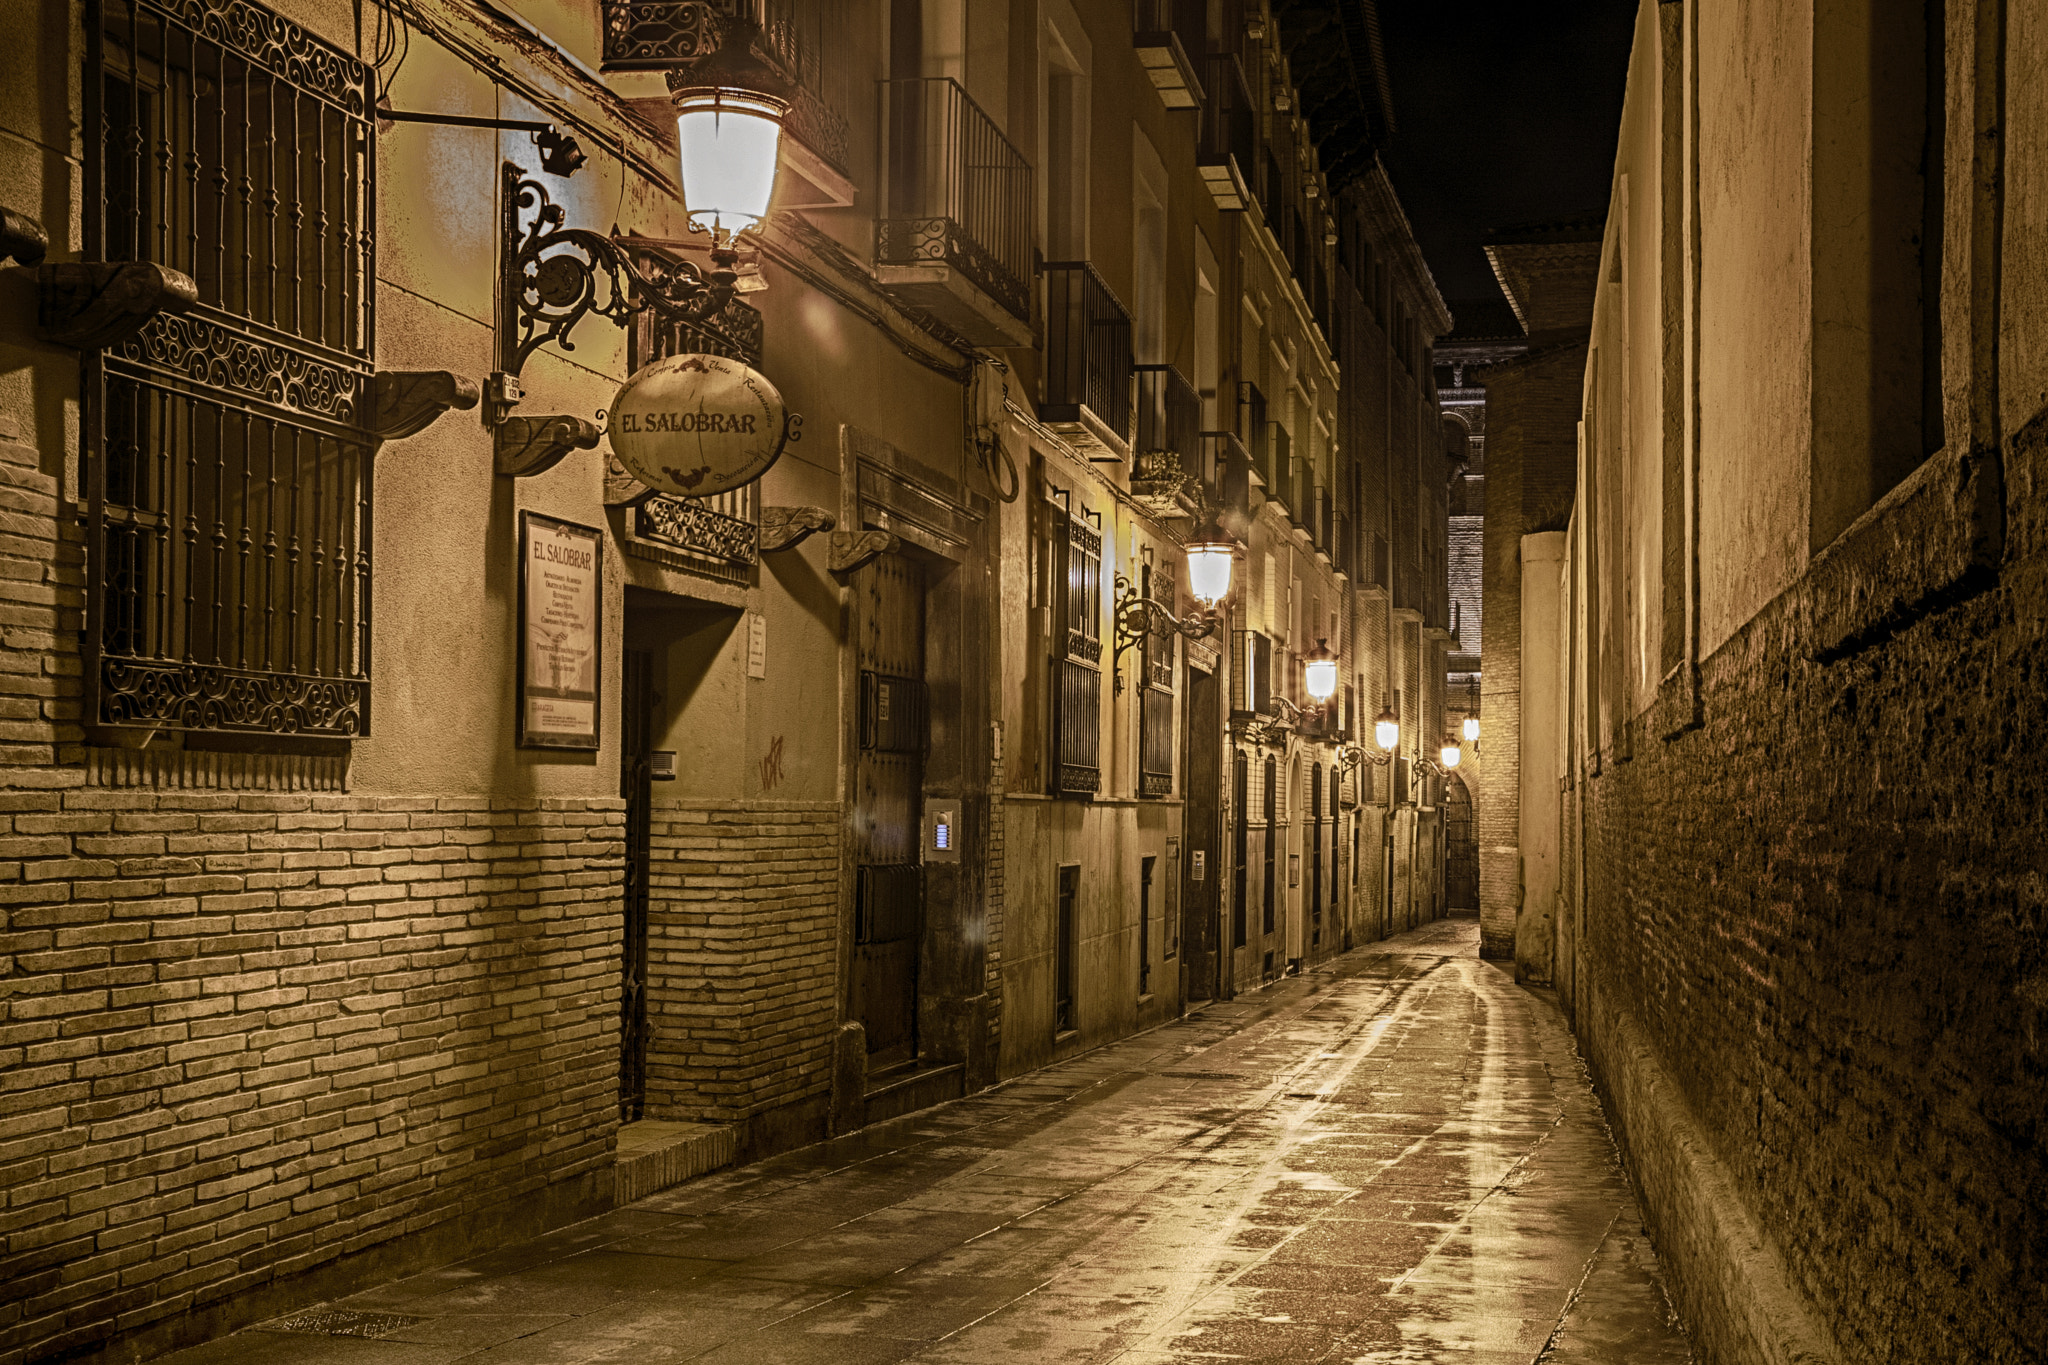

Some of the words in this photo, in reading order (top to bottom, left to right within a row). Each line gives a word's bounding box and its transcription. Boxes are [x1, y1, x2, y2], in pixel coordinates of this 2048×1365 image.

[708, 360, 731, 375] Venta
[622, 413, 642, 434] EL
[645, 412, 756, 435] SALOBRAR
[534, 541, 546, 560] EL
[547, 543, 591, 571] SALOBRAR
